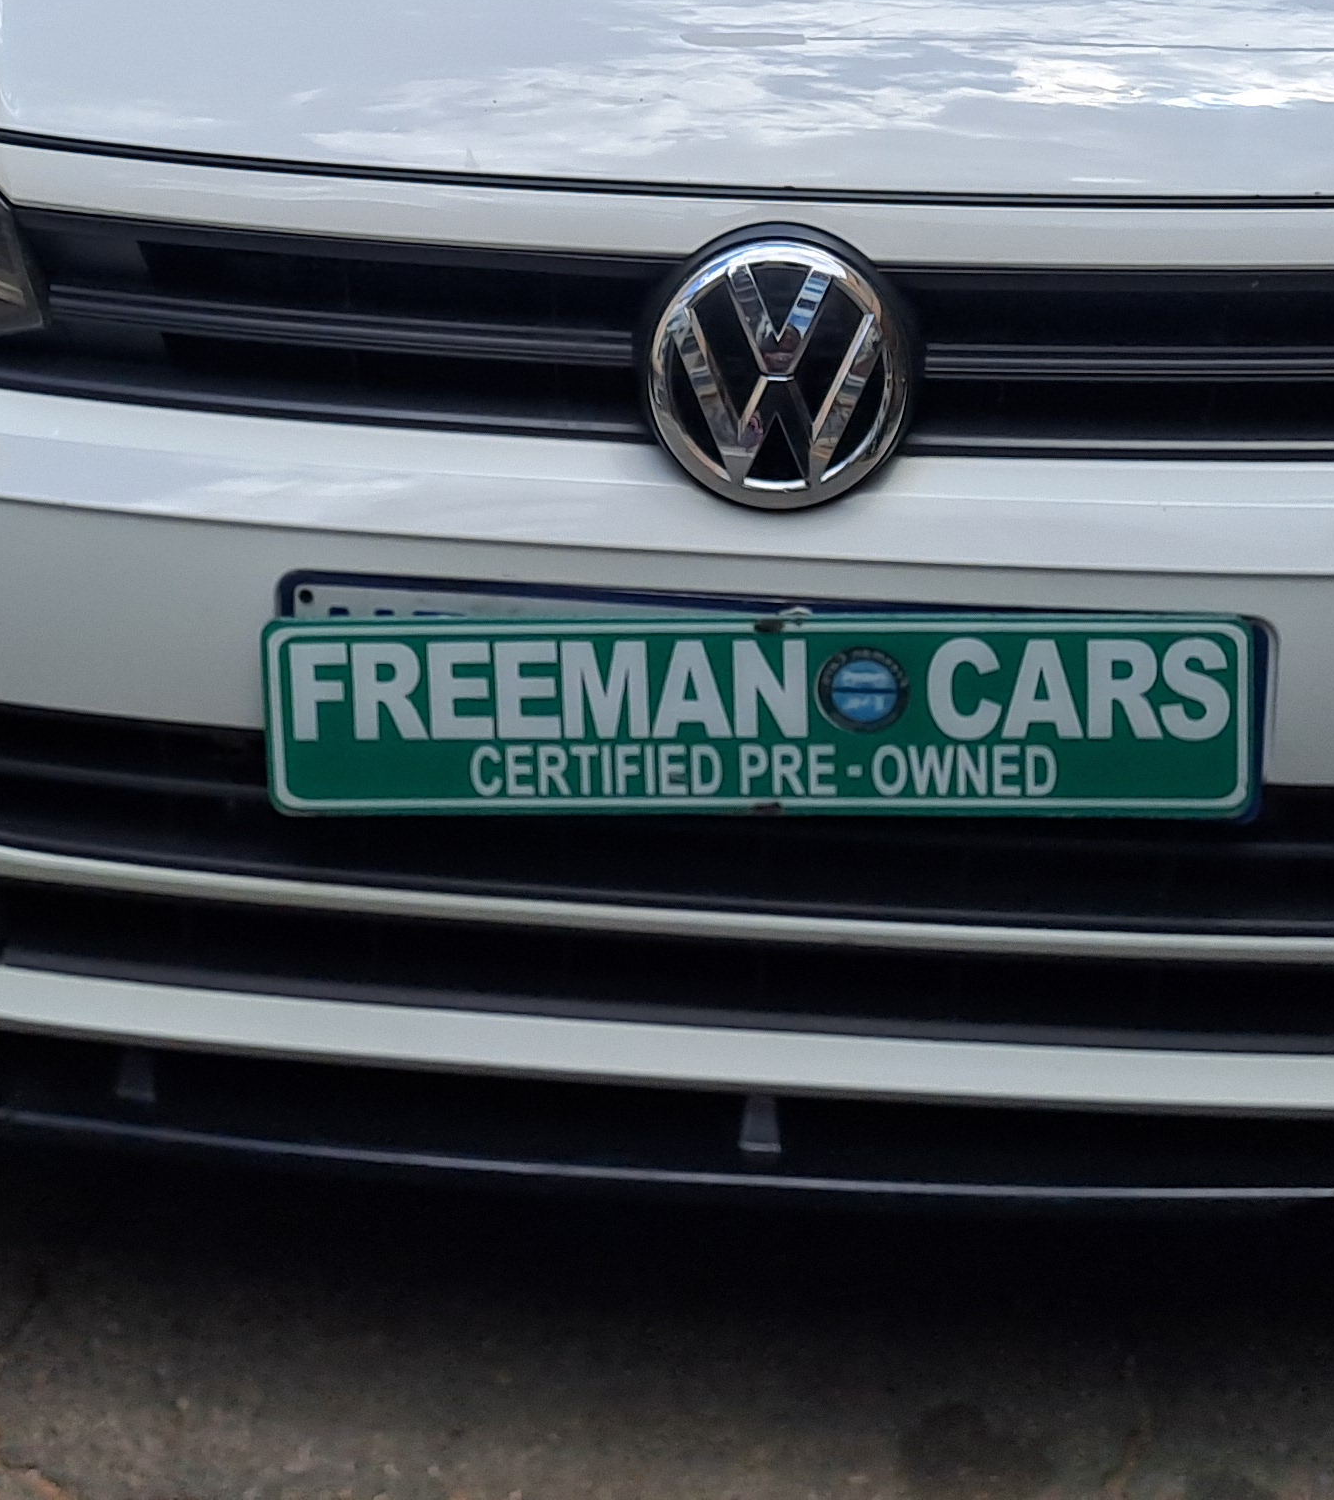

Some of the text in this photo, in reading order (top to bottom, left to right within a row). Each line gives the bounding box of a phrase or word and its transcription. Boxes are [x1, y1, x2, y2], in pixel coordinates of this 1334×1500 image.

[289, 638, 808, 742] FREEMAN
[926, 638, 1231, 742] CARS
[469, 744, 723, 797] CERTIFIED
